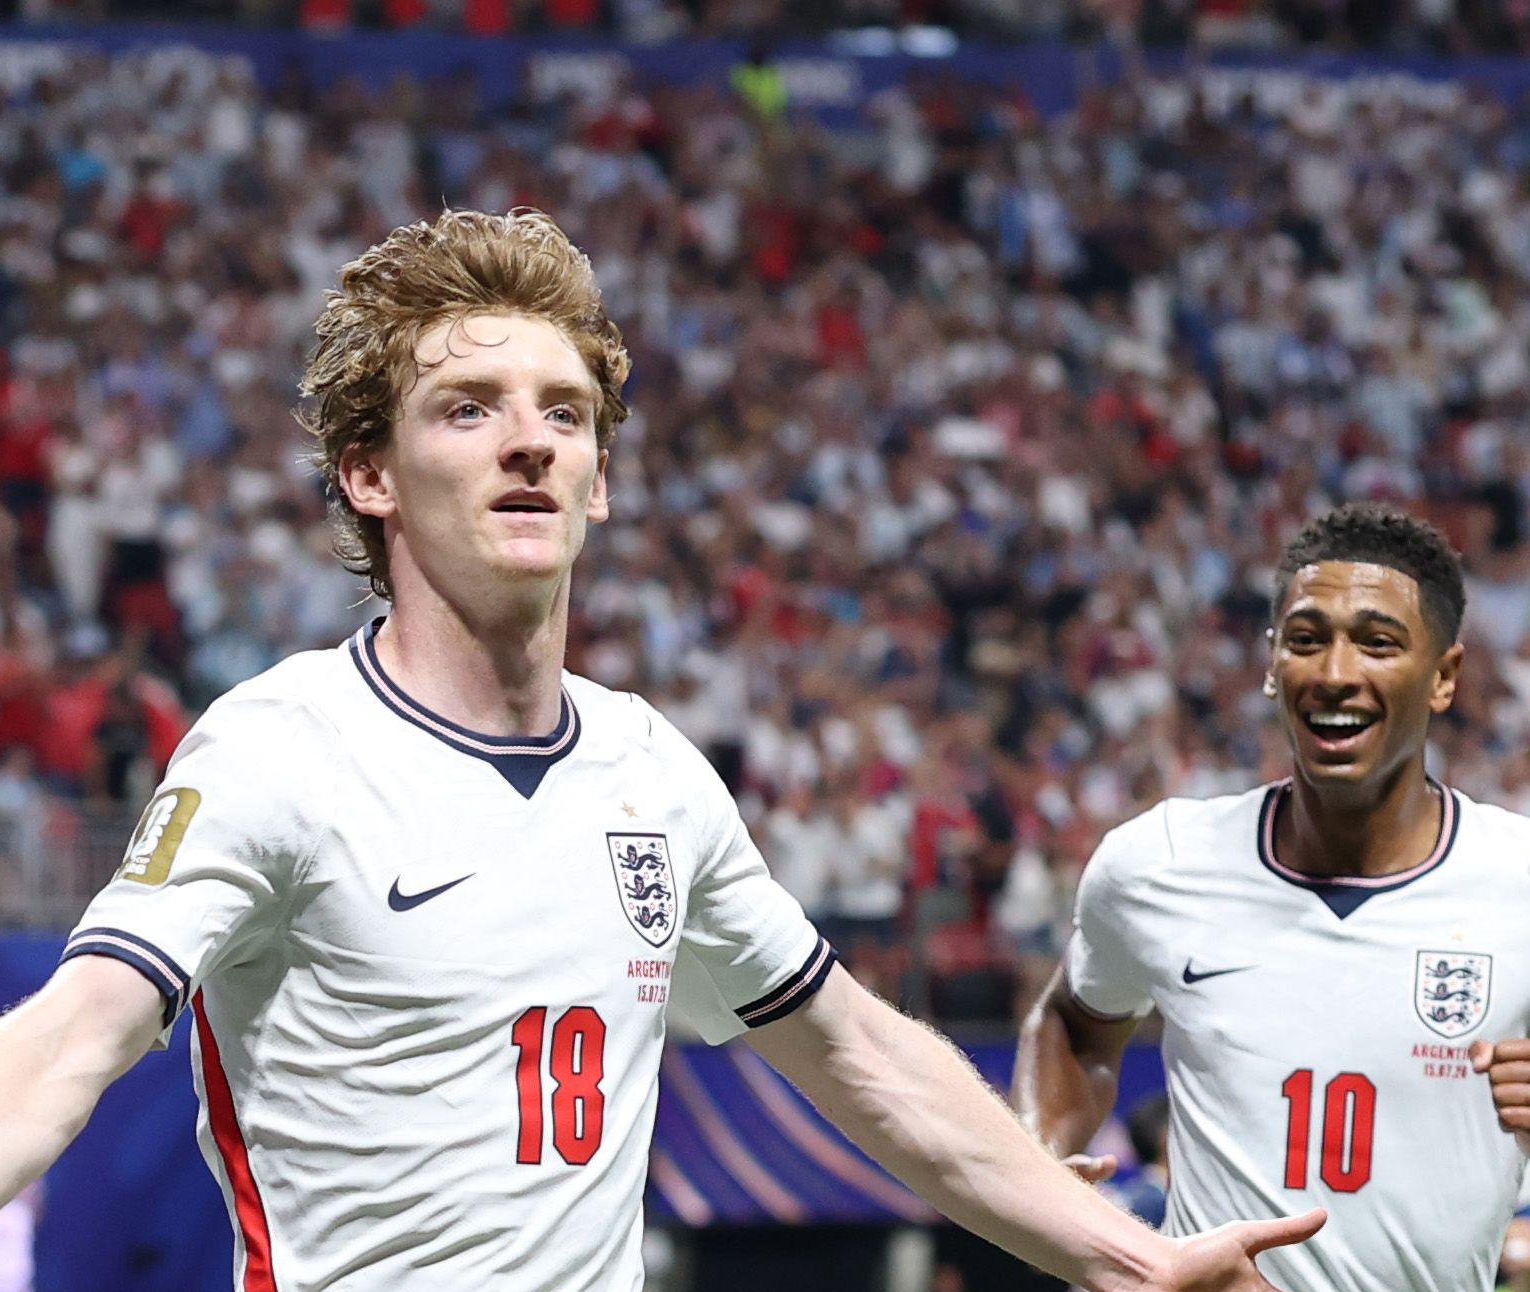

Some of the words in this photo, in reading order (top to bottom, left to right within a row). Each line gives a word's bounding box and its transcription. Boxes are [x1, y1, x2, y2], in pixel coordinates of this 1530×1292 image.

[511, 1006, 607, 1166] 18
[1412, 1043, 1470, 1060] ARGENTI
[1281, 1068, 1377, 1194] 10
